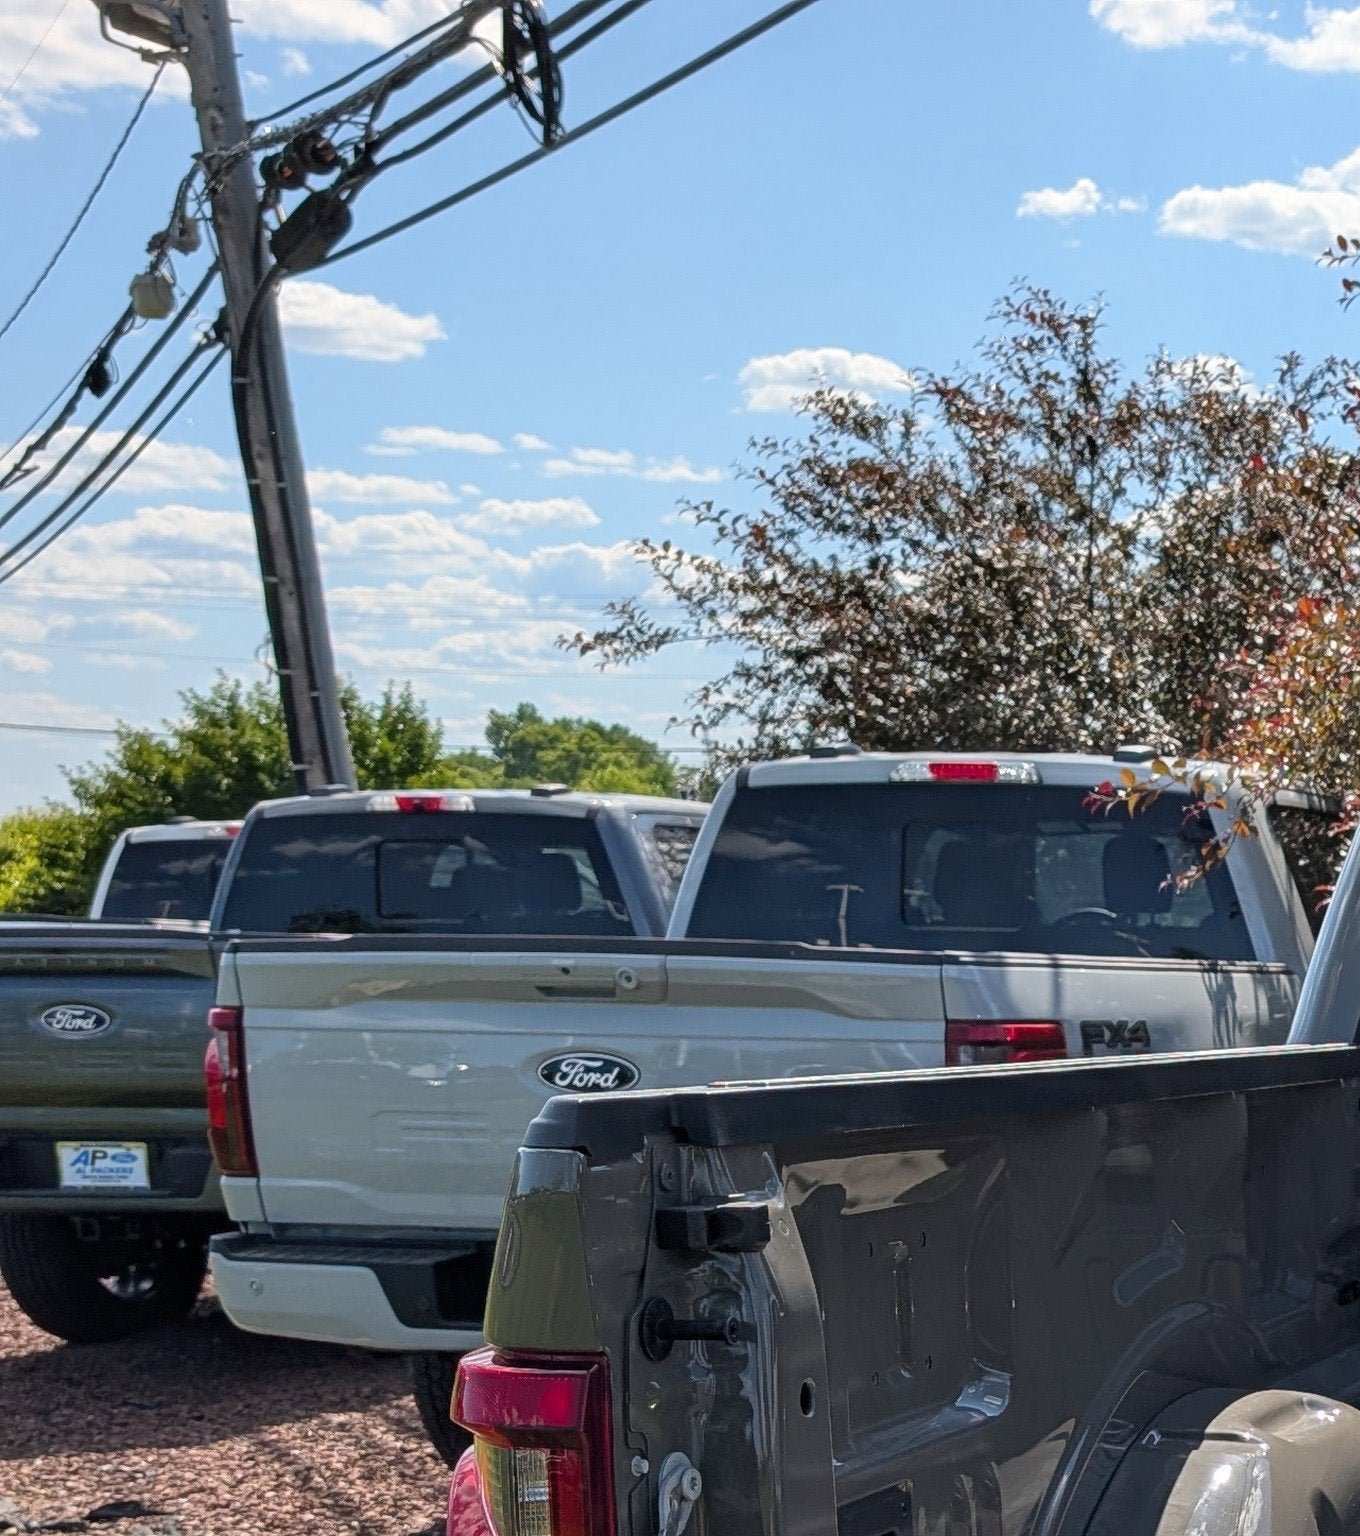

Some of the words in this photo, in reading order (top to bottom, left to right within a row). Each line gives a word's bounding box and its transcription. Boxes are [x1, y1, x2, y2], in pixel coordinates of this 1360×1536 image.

[51, 1006, 99, 1031] Ford
[1080, 1020, 1151, 1056] FX4
[554, 1057, 622, 1090] Ford
